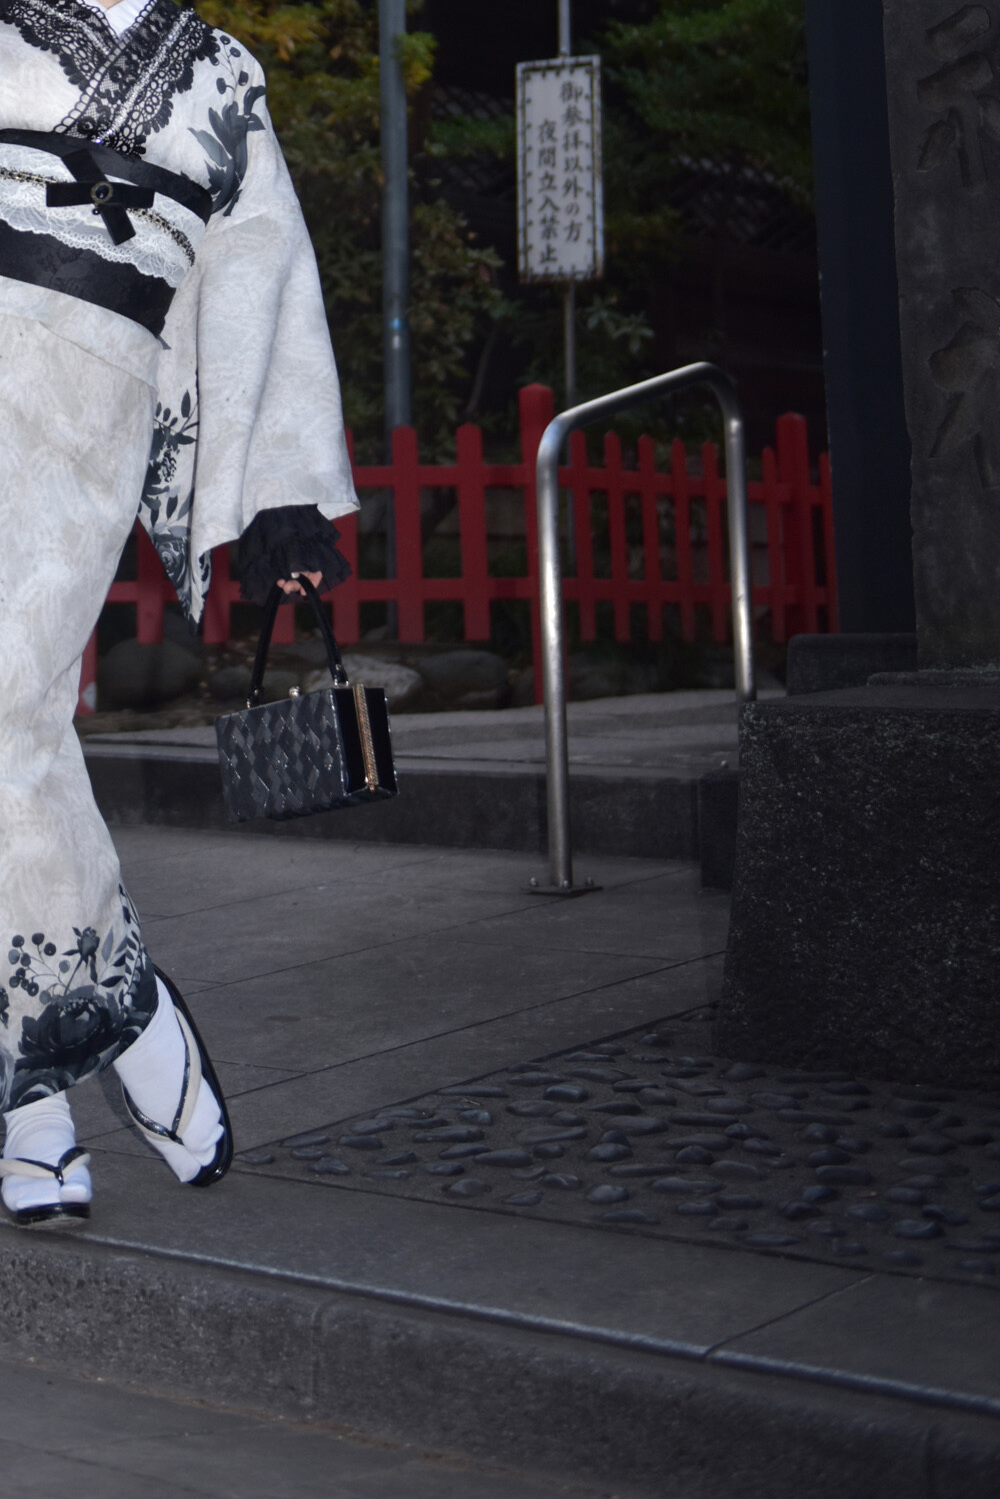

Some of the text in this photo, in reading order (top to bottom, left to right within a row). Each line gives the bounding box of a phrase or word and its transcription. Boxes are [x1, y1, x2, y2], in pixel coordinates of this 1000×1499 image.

[538, 119, 559, 264] 夜間立入禁止
